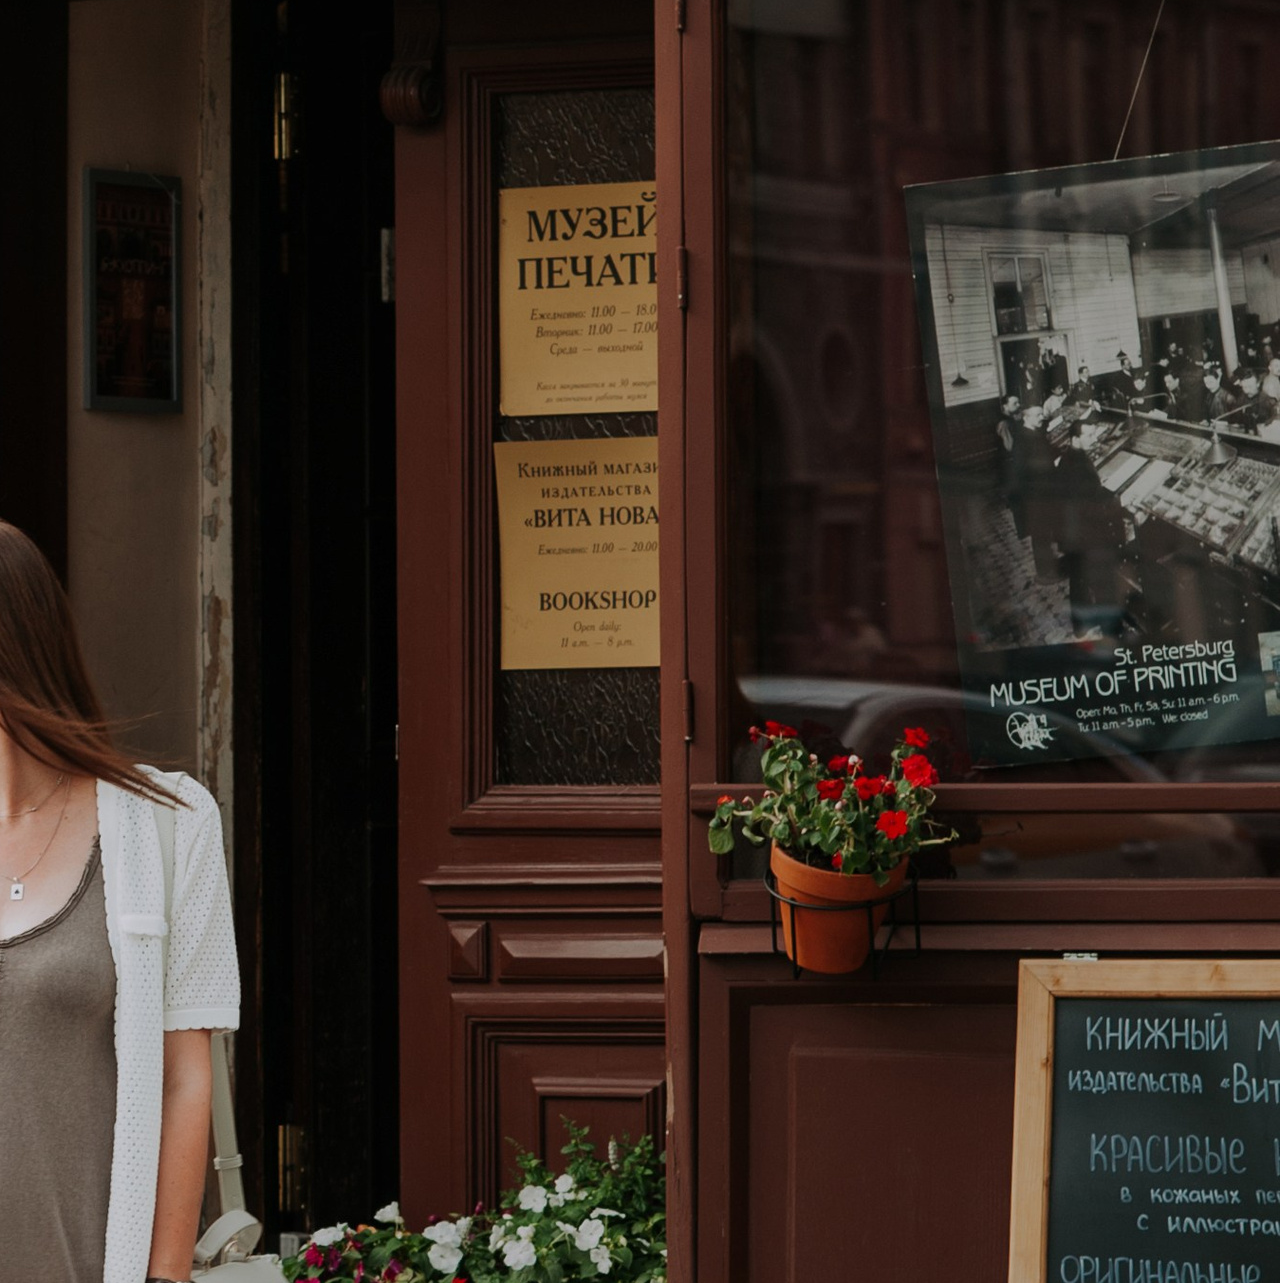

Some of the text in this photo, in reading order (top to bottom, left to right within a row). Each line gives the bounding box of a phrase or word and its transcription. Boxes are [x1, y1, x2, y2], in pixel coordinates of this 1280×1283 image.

[527, 191, 657, 242] МУЗЕЙ
[591, 305, 616, 318] 11.00
[588, 323, 613, 336] 11.00
[633, 321, 658, 334] 17.00
[524, 506, 659, 528] «ВИТА НОВА
[592, 542, 615, 554] 11.00
[631, 541, 658, 553] 20.00
[539, 590, 657, 611] BOOKSHOP
[573, 621, 596, 634] Open
[561, 637, 569, 648] 11
[1113, 639, 1235, 666] St. Petersburg
[990, 657, 1237, 707] MUSEUM OF PRINTING
[1180, 709, 1208, 722] closed
[1086, 1012, 1228, 1051] КНИЖНЫЙ
[1256, 1188, 1280, 1206] пе
